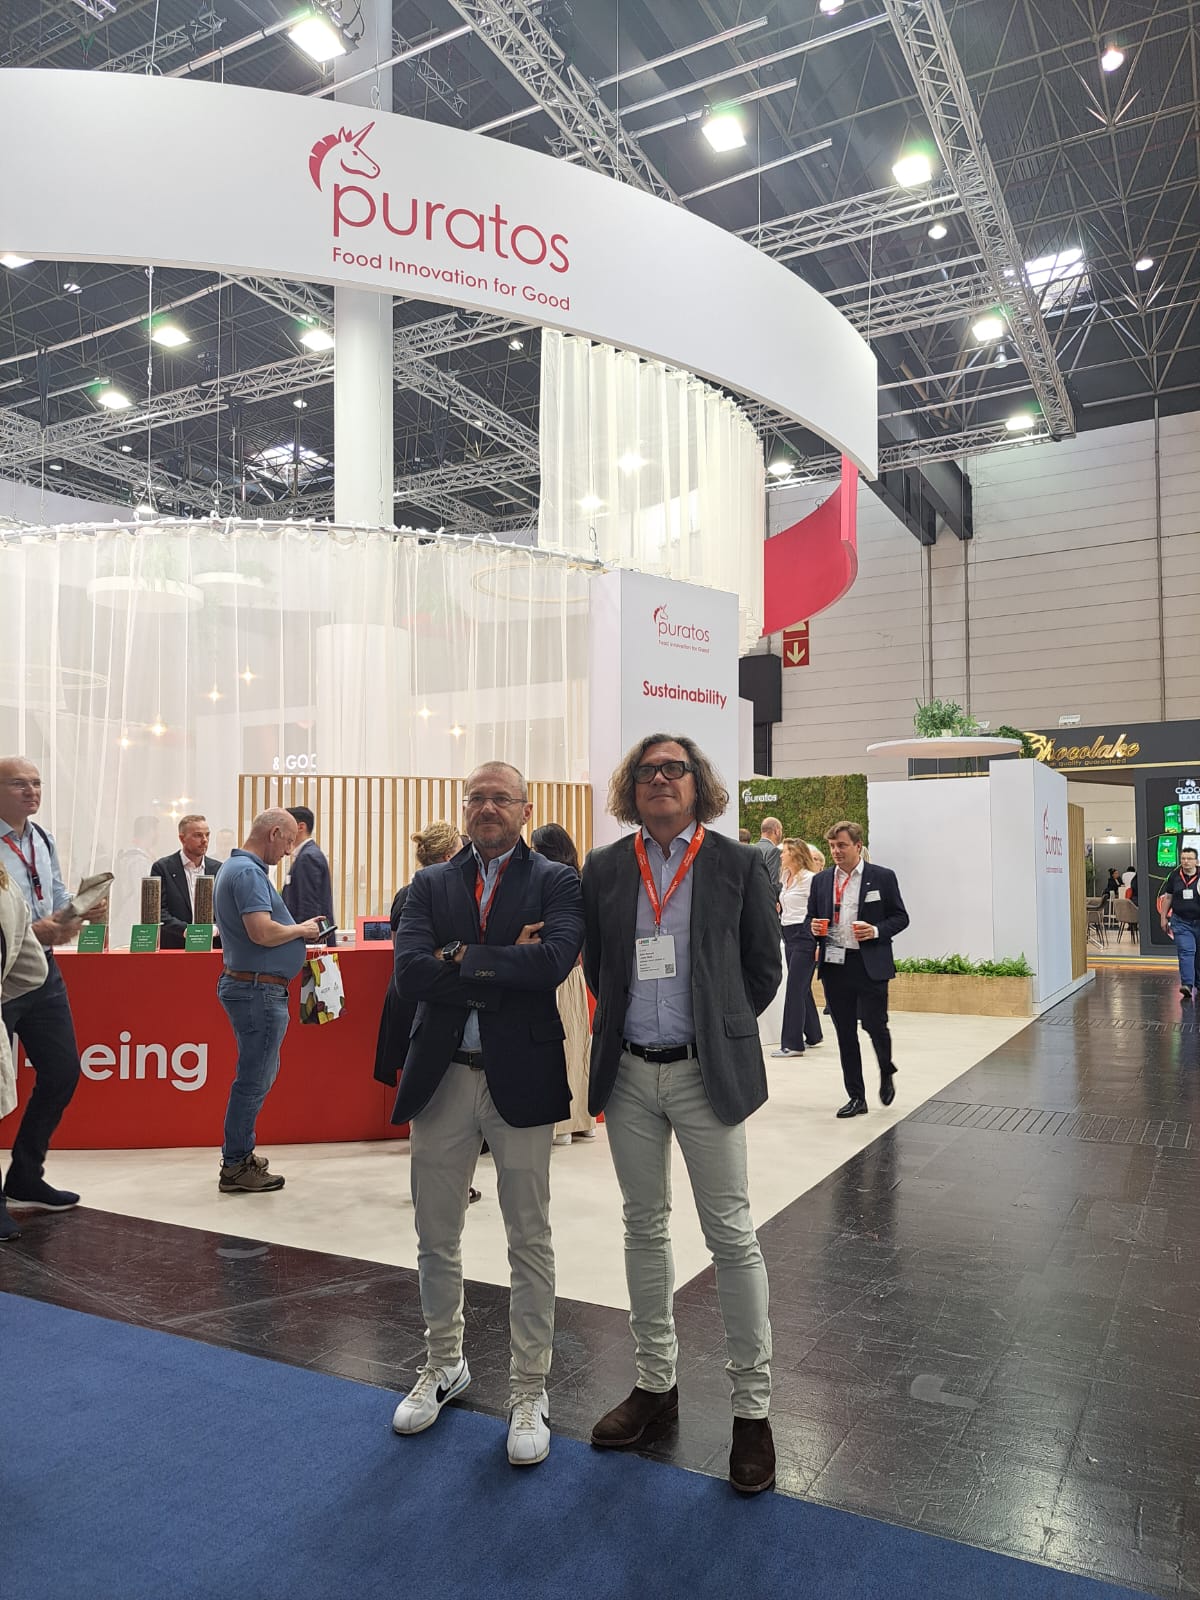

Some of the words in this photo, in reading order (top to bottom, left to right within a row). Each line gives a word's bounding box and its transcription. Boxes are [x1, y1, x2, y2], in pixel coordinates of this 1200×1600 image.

[333, 183, 570, 274] puratos
[332, 247, 382, 270] Food
[389, 256, 488, 290] Innovation
[493, 277, 517, 297] for
[522, 285, 570, 311] Good
[658, 621, 710, 642] puratos
[642, 680, 728, 709] Sustainability
[1058, 759, 1082, 768] quality
[1084, 758, 1127, 766] guaranteed
[744, 792, 778, 805] puratos
